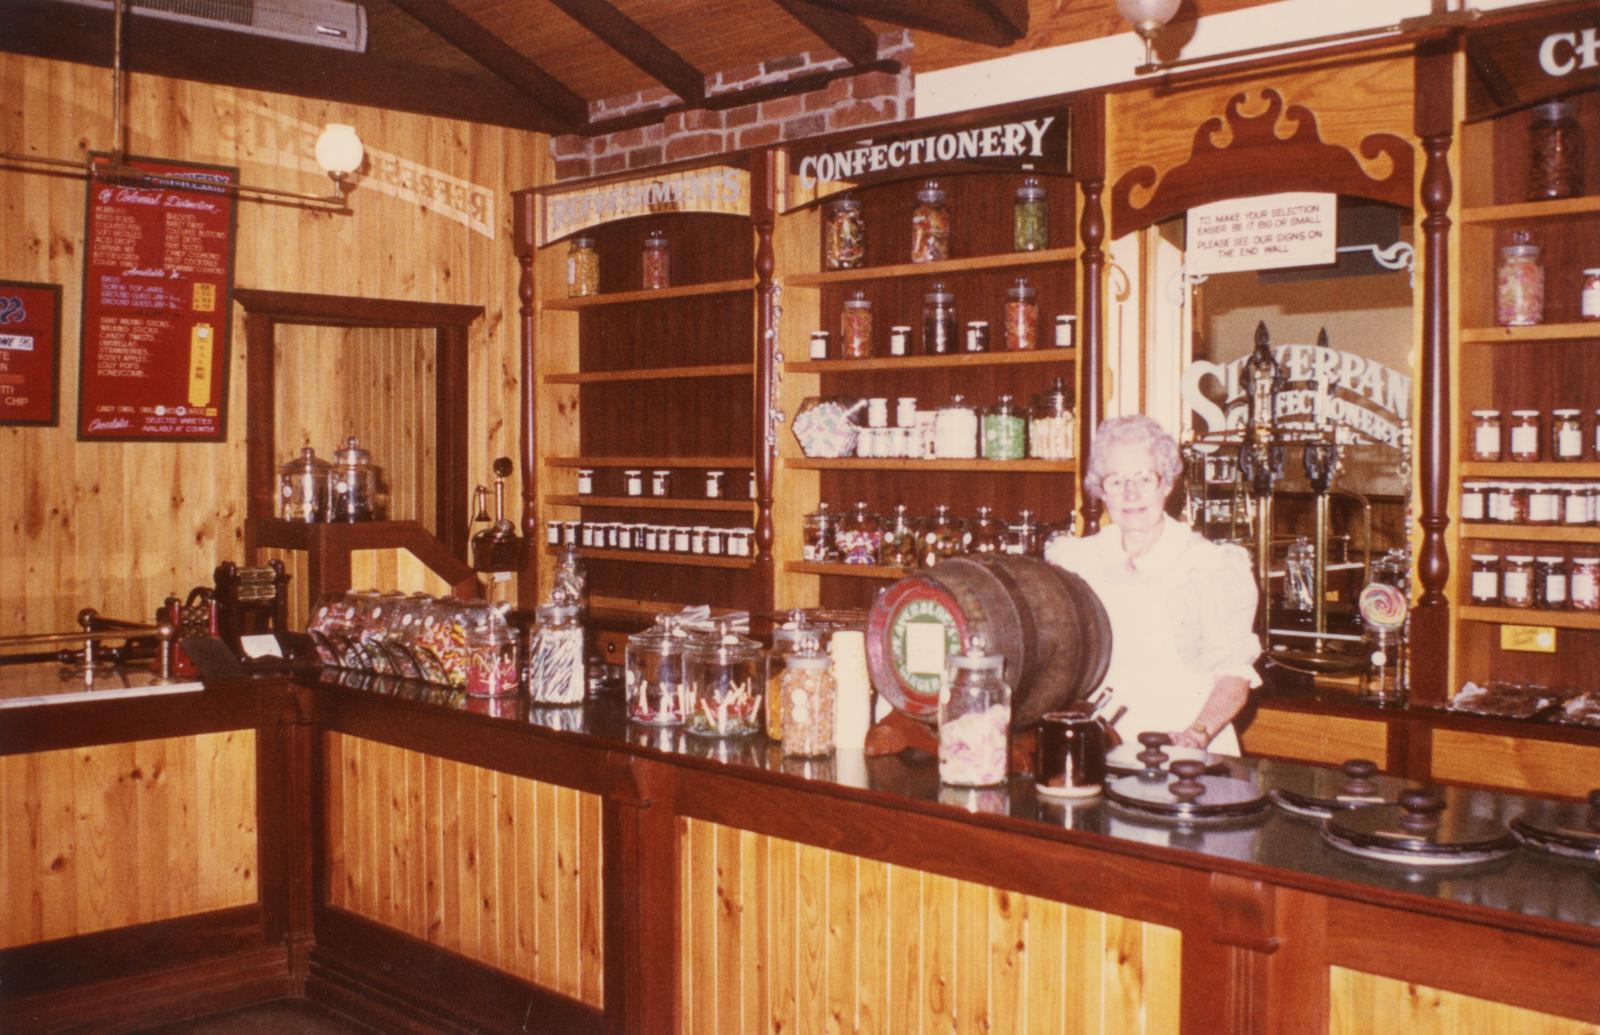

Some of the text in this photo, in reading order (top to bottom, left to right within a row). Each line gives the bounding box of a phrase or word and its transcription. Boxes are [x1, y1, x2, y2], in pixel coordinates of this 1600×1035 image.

[799, 116, 1055, 190] CONFECTIONERY
[551, 168, 743, 232] REFRESHMENTS
[1198, 215, 1321, 235] EASIER BE IT BIG OR SMALL
[1199, 205, 1320, 225] TO MAKE YOUR SELECTION
[1197, 230, 1322, 249] PLEASE SEE OUR SIGNS ON
[1218, 245, 1289, 258] THE END WALL
[4, 396, 29, 407] CHIP
[1189, 344, 1411, 452] SIERPAN
